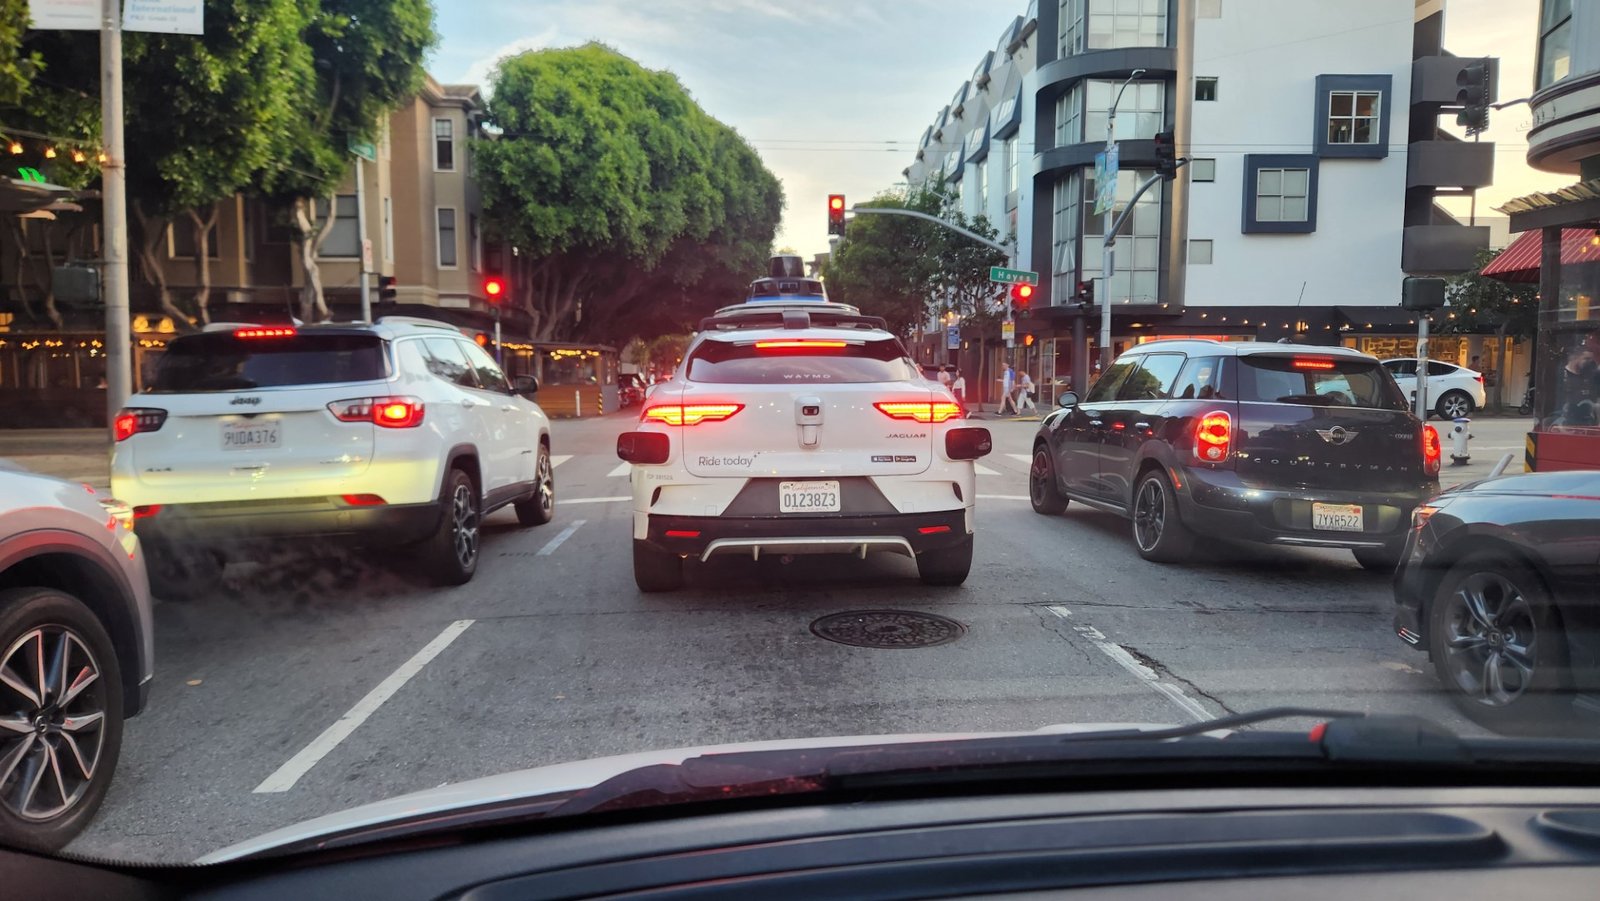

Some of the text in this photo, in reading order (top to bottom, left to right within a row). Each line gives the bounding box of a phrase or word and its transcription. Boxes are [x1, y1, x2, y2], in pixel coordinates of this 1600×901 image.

[131, 4, 196, 13] International
[998, 271, 1031, 282] Hayes
[230, 396, 262, 406] Jeep
[698, 456, 753, 467] Ride today
[1254, 458, 1408, 472] COUNTRYMAN
[784, 492, 836, 508] 01238Z3
[1317, 513, 1359, 526] 7YXR522
